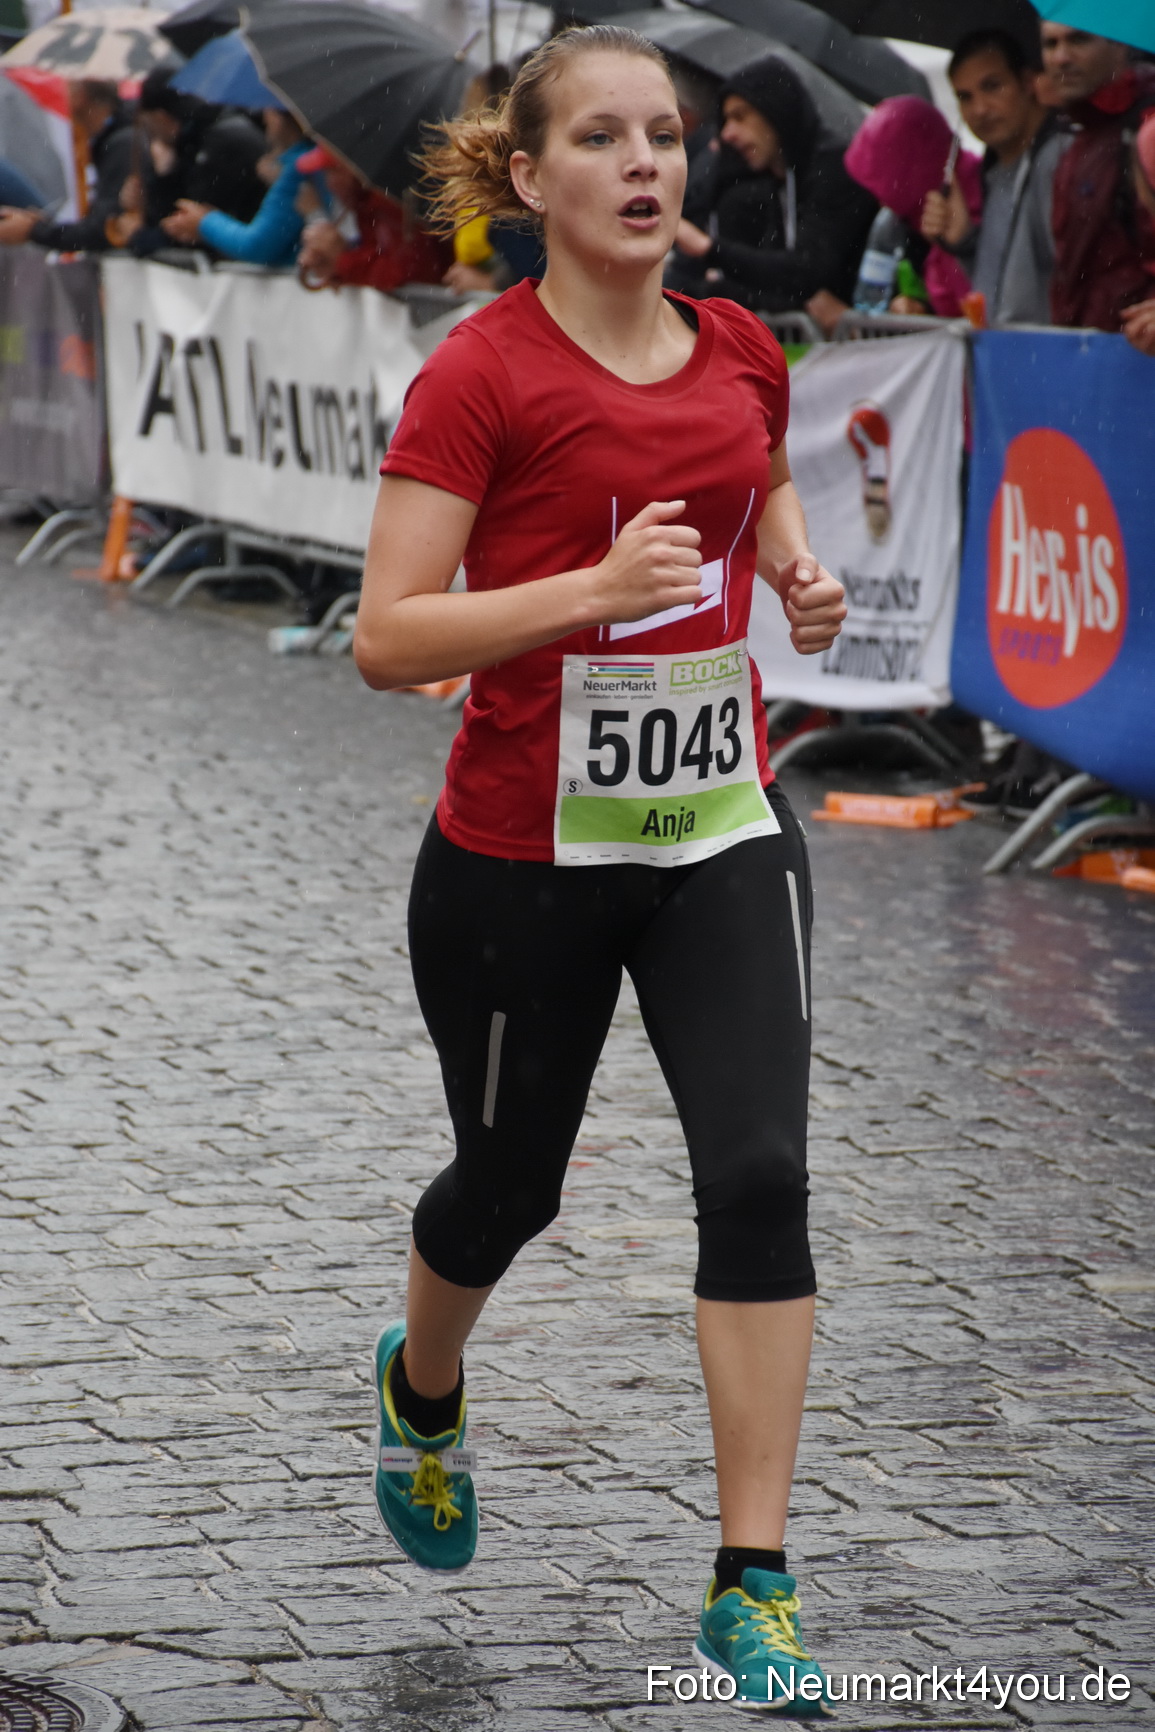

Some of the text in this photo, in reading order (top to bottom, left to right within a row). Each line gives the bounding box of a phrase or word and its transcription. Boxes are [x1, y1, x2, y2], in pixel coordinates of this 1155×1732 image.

[997, 482, 1119, 658] Hervis
[670, 649, 742, 686] BOCK
[583, 680, 657, 692] NeuerMarkt
[587, 697, 742, 787] 5043
[568, 780, 577, 793] S
[641, 806, 696, 842] Anja
